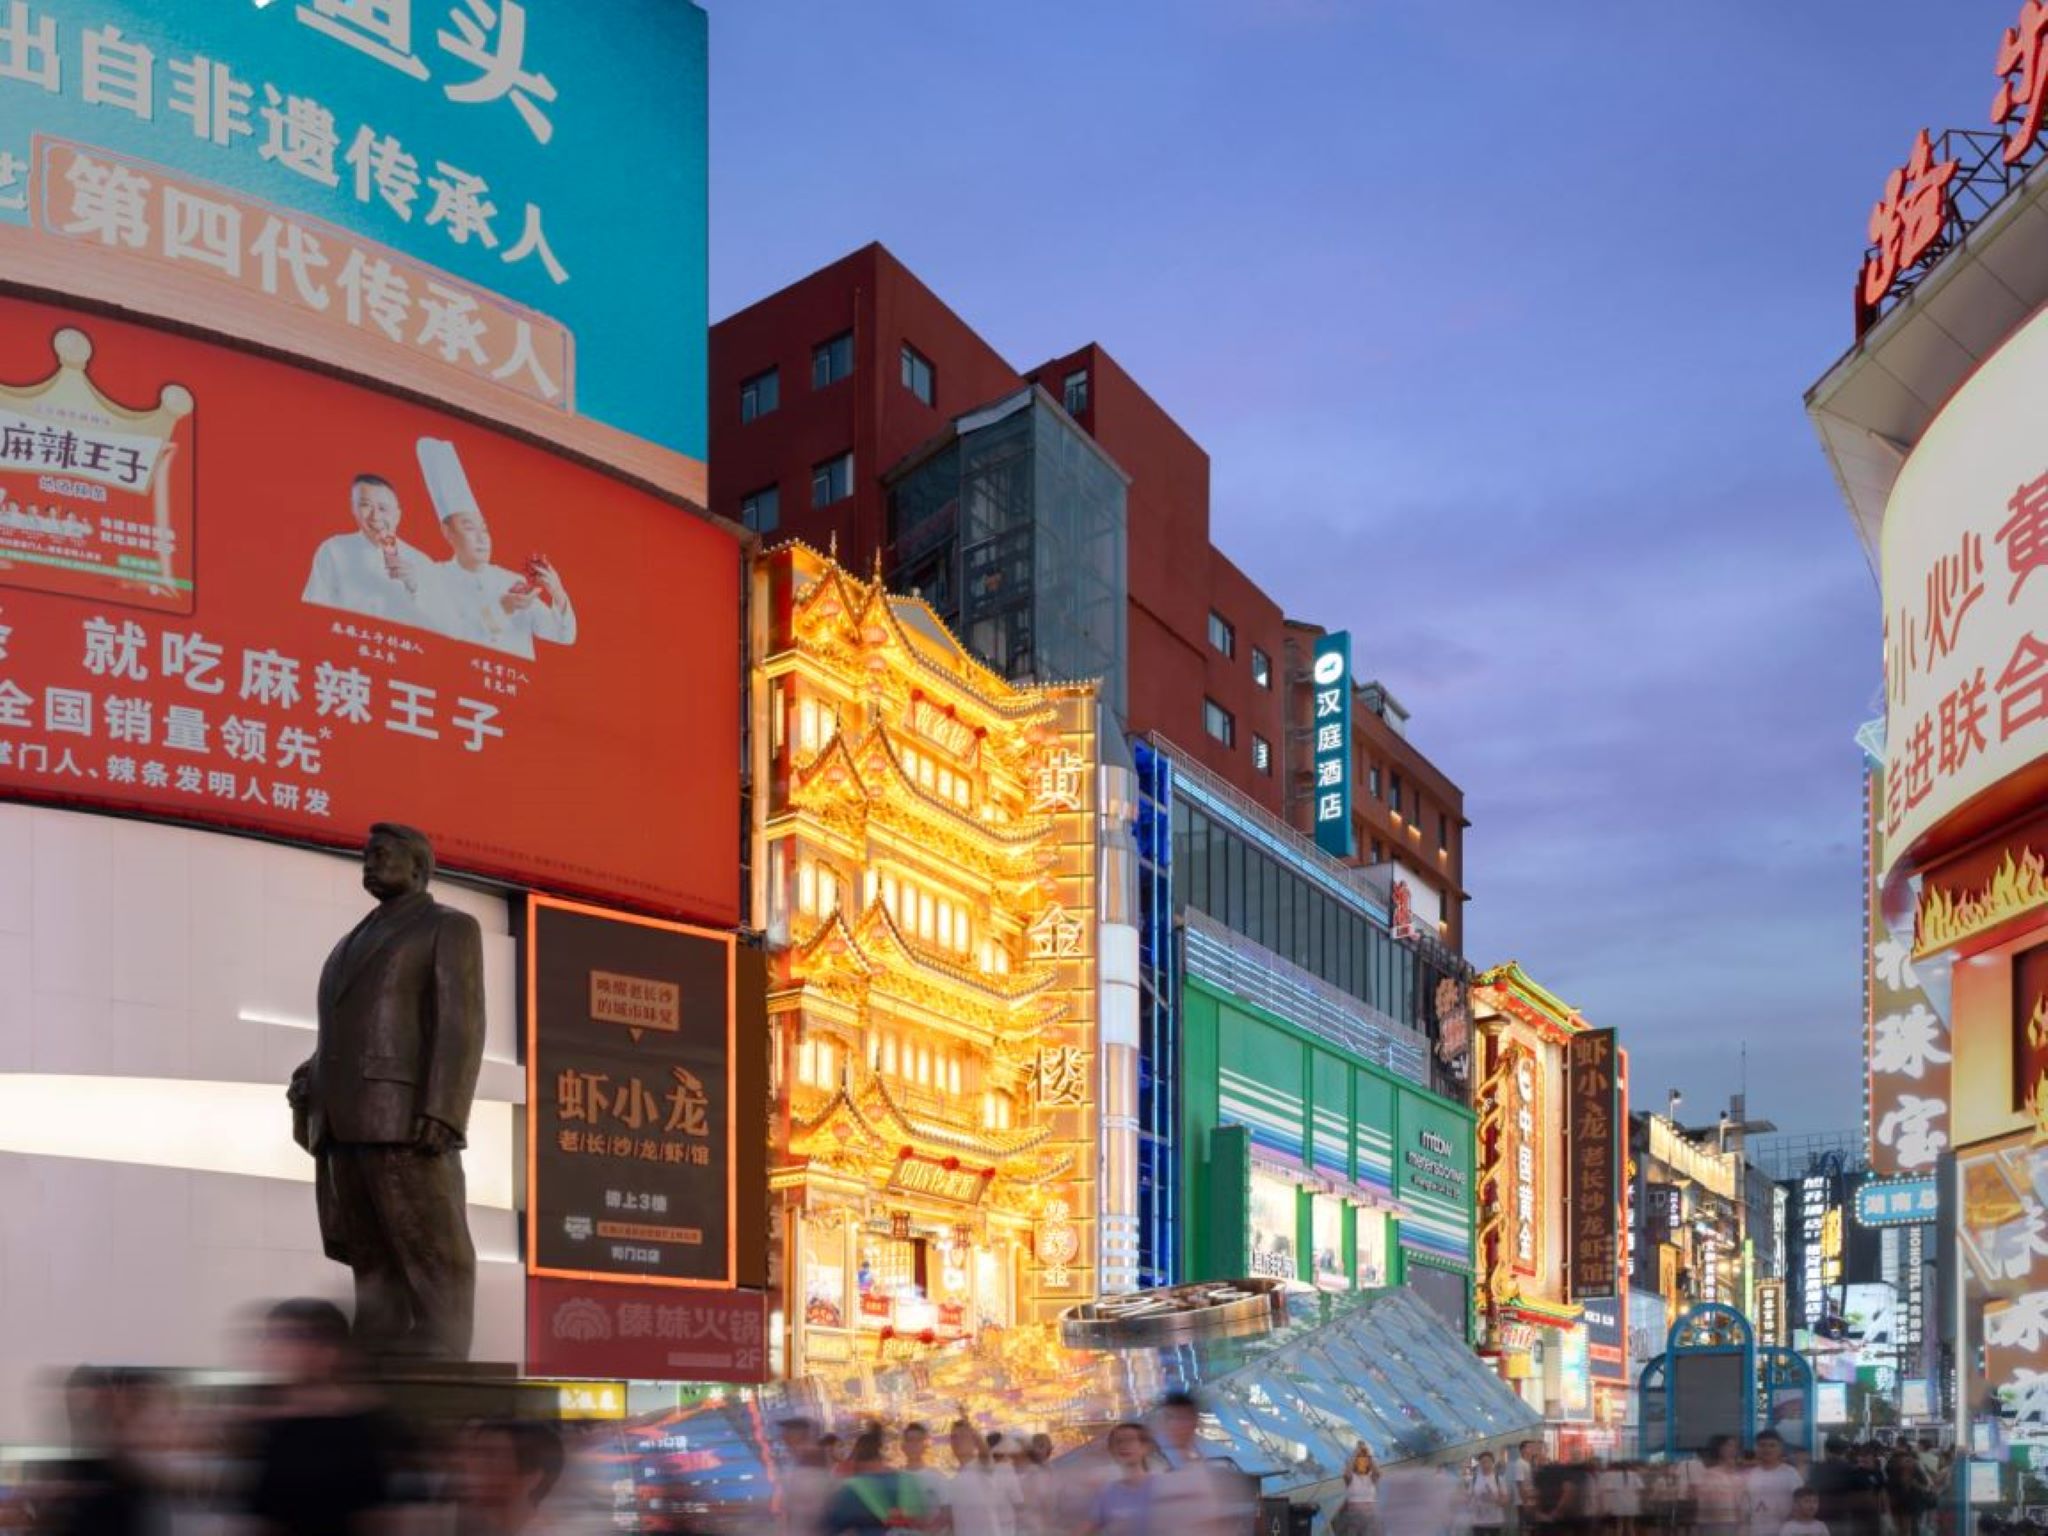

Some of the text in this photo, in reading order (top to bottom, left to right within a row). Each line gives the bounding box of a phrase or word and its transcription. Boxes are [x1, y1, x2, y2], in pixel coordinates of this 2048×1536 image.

[0, 2, 570, 285] 出自非遗传承人
[62, 155, 560, 399] 第四代传承人
[1, 422, 149, 484] 麻辣王子
[82, 616, 505, 753] 就吃麻辣王子
[1316, 688, 1343, 822] 汉庭酒店
[558, 1065, 709, 1136] 虾小龙
[735, 1349, 761, 1369] 2F
